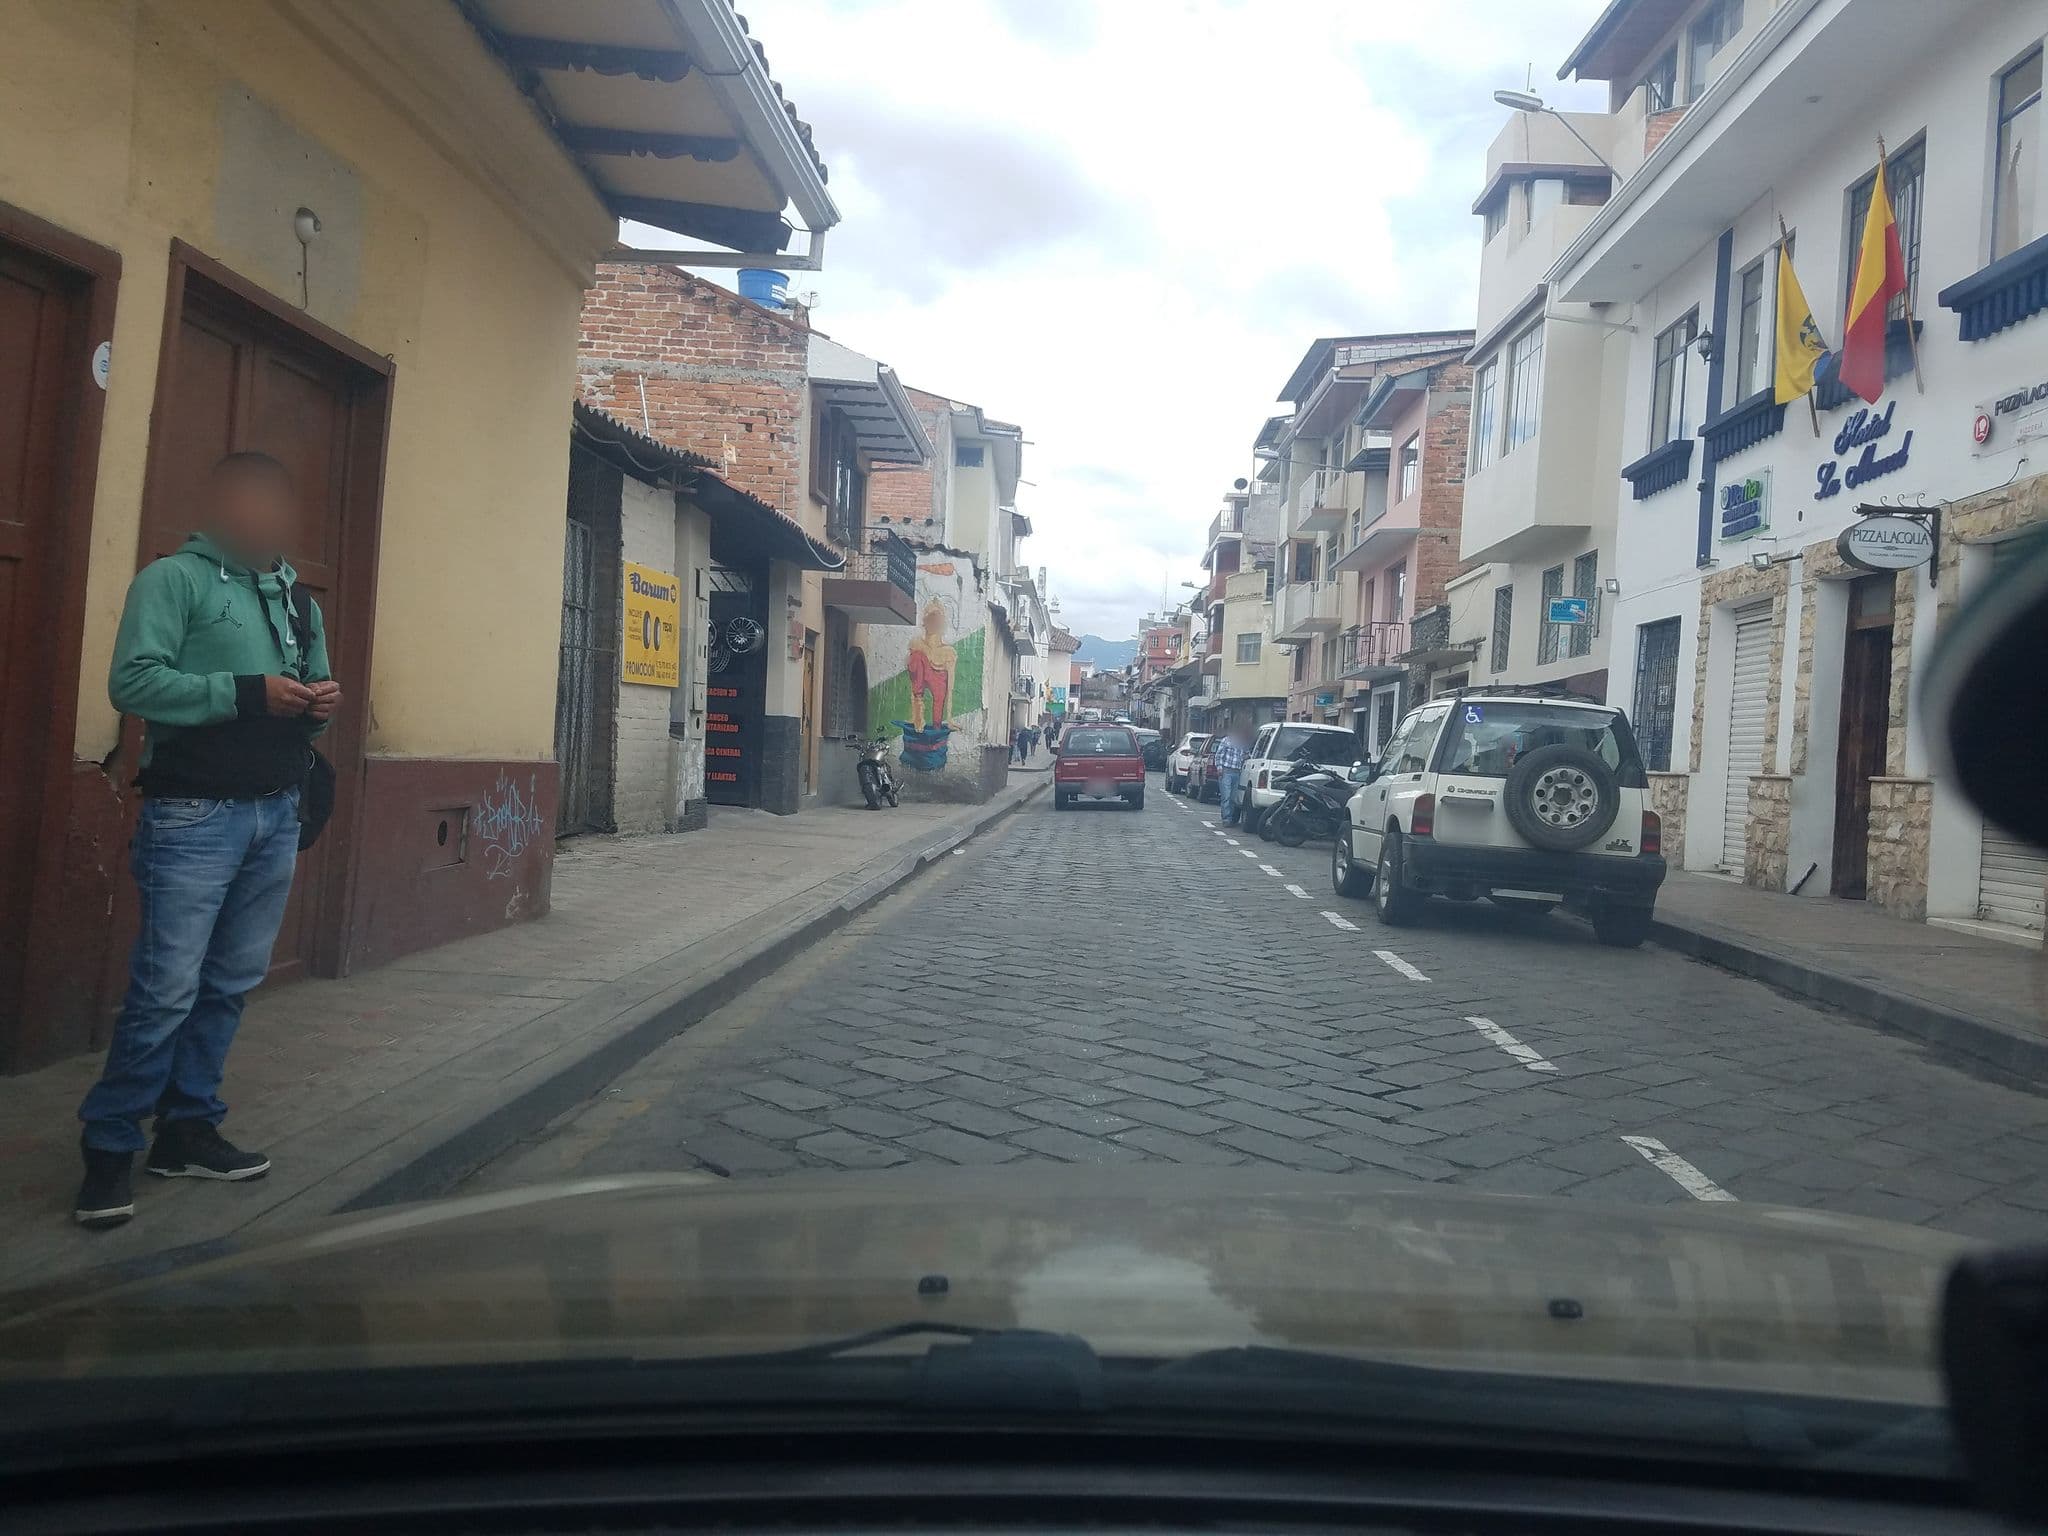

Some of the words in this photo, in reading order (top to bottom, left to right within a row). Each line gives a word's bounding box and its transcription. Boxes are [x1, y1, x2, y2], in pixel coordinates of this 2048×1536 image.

[1994, 381, 2048, 416] PIZZALAC
[1834, 400, 1896, 455] Hotel
[1852, 529, 1929, 545] PIZZALACQUA
[628, 571, 669, 602] Barum
[1457, 787, 1498, 796] CHEVROLET
